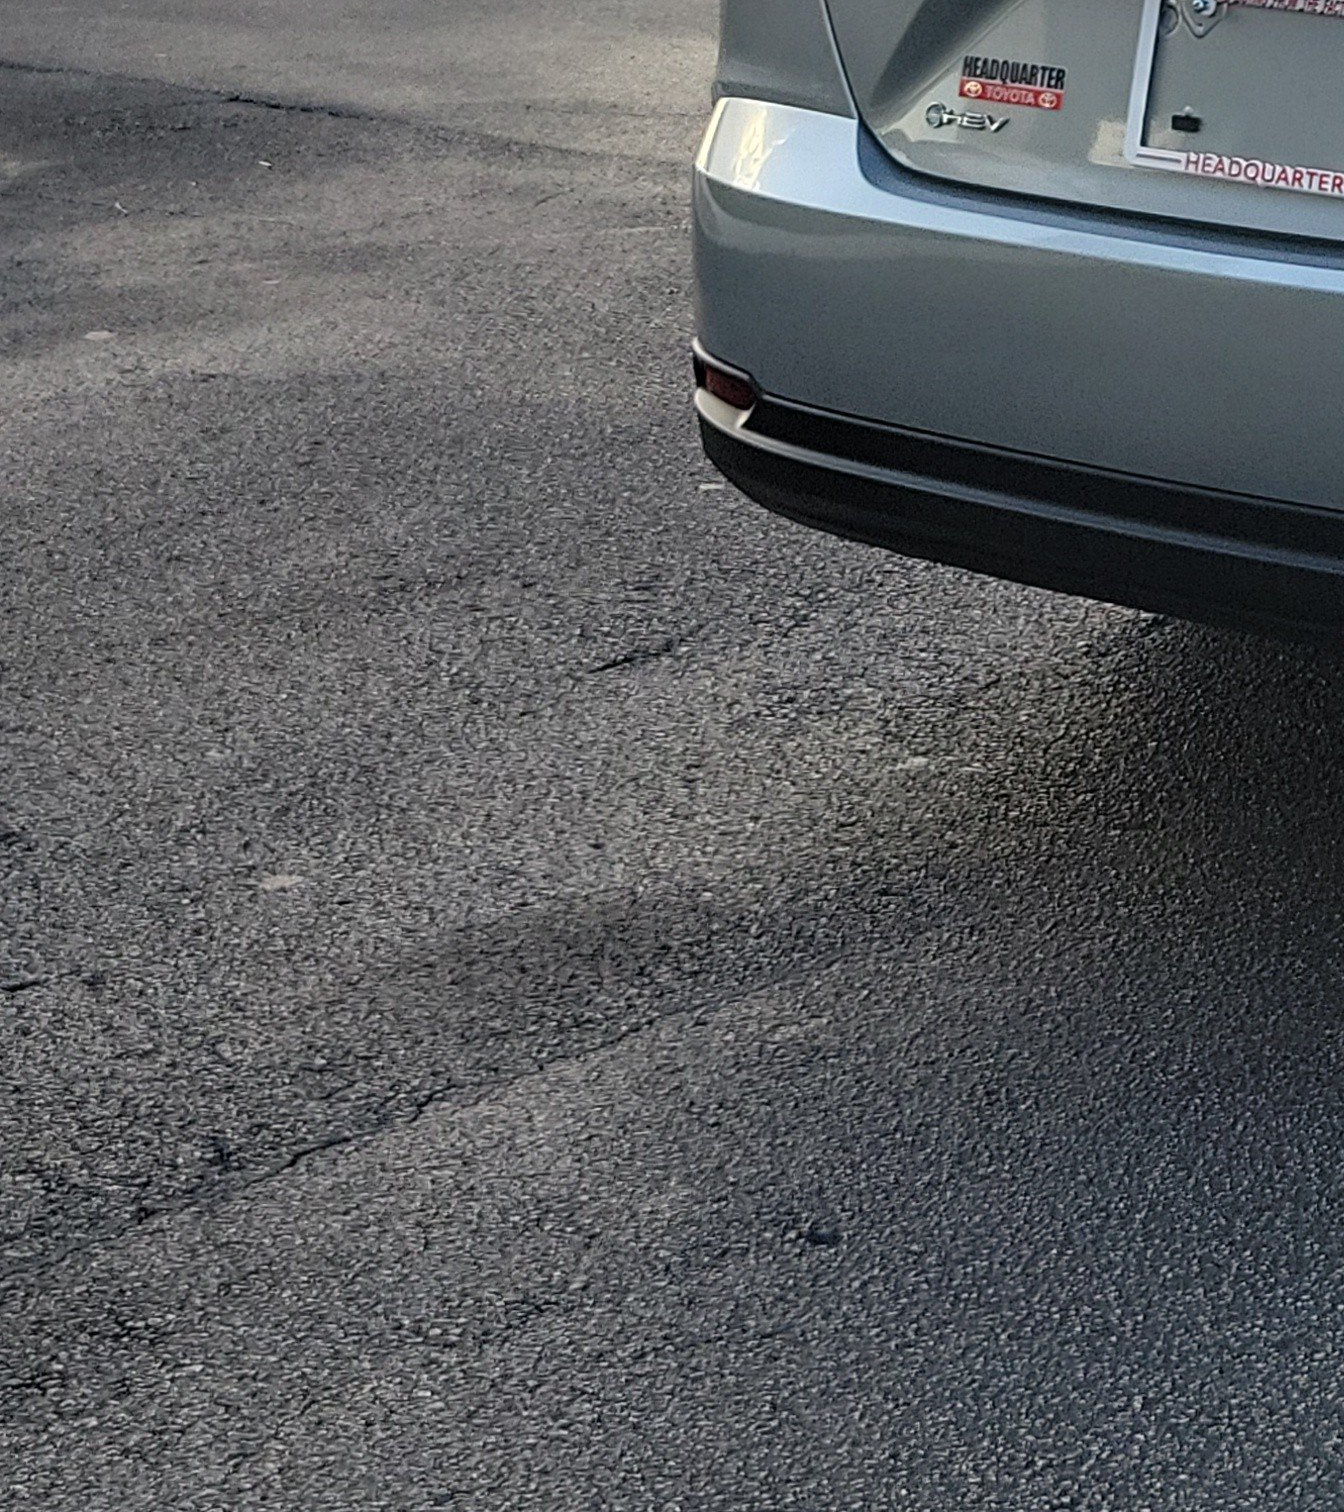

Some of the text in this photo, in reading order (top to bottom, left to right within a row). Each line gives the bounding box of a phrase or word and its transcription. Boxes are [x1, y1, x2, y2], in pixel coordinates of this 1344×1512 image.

[962, 55, 1066, 89] HEADQUARTER
[985, 84, 1035, 105] TOYOTA
[1184, 152, 1344, 194] HEADQUARTER
